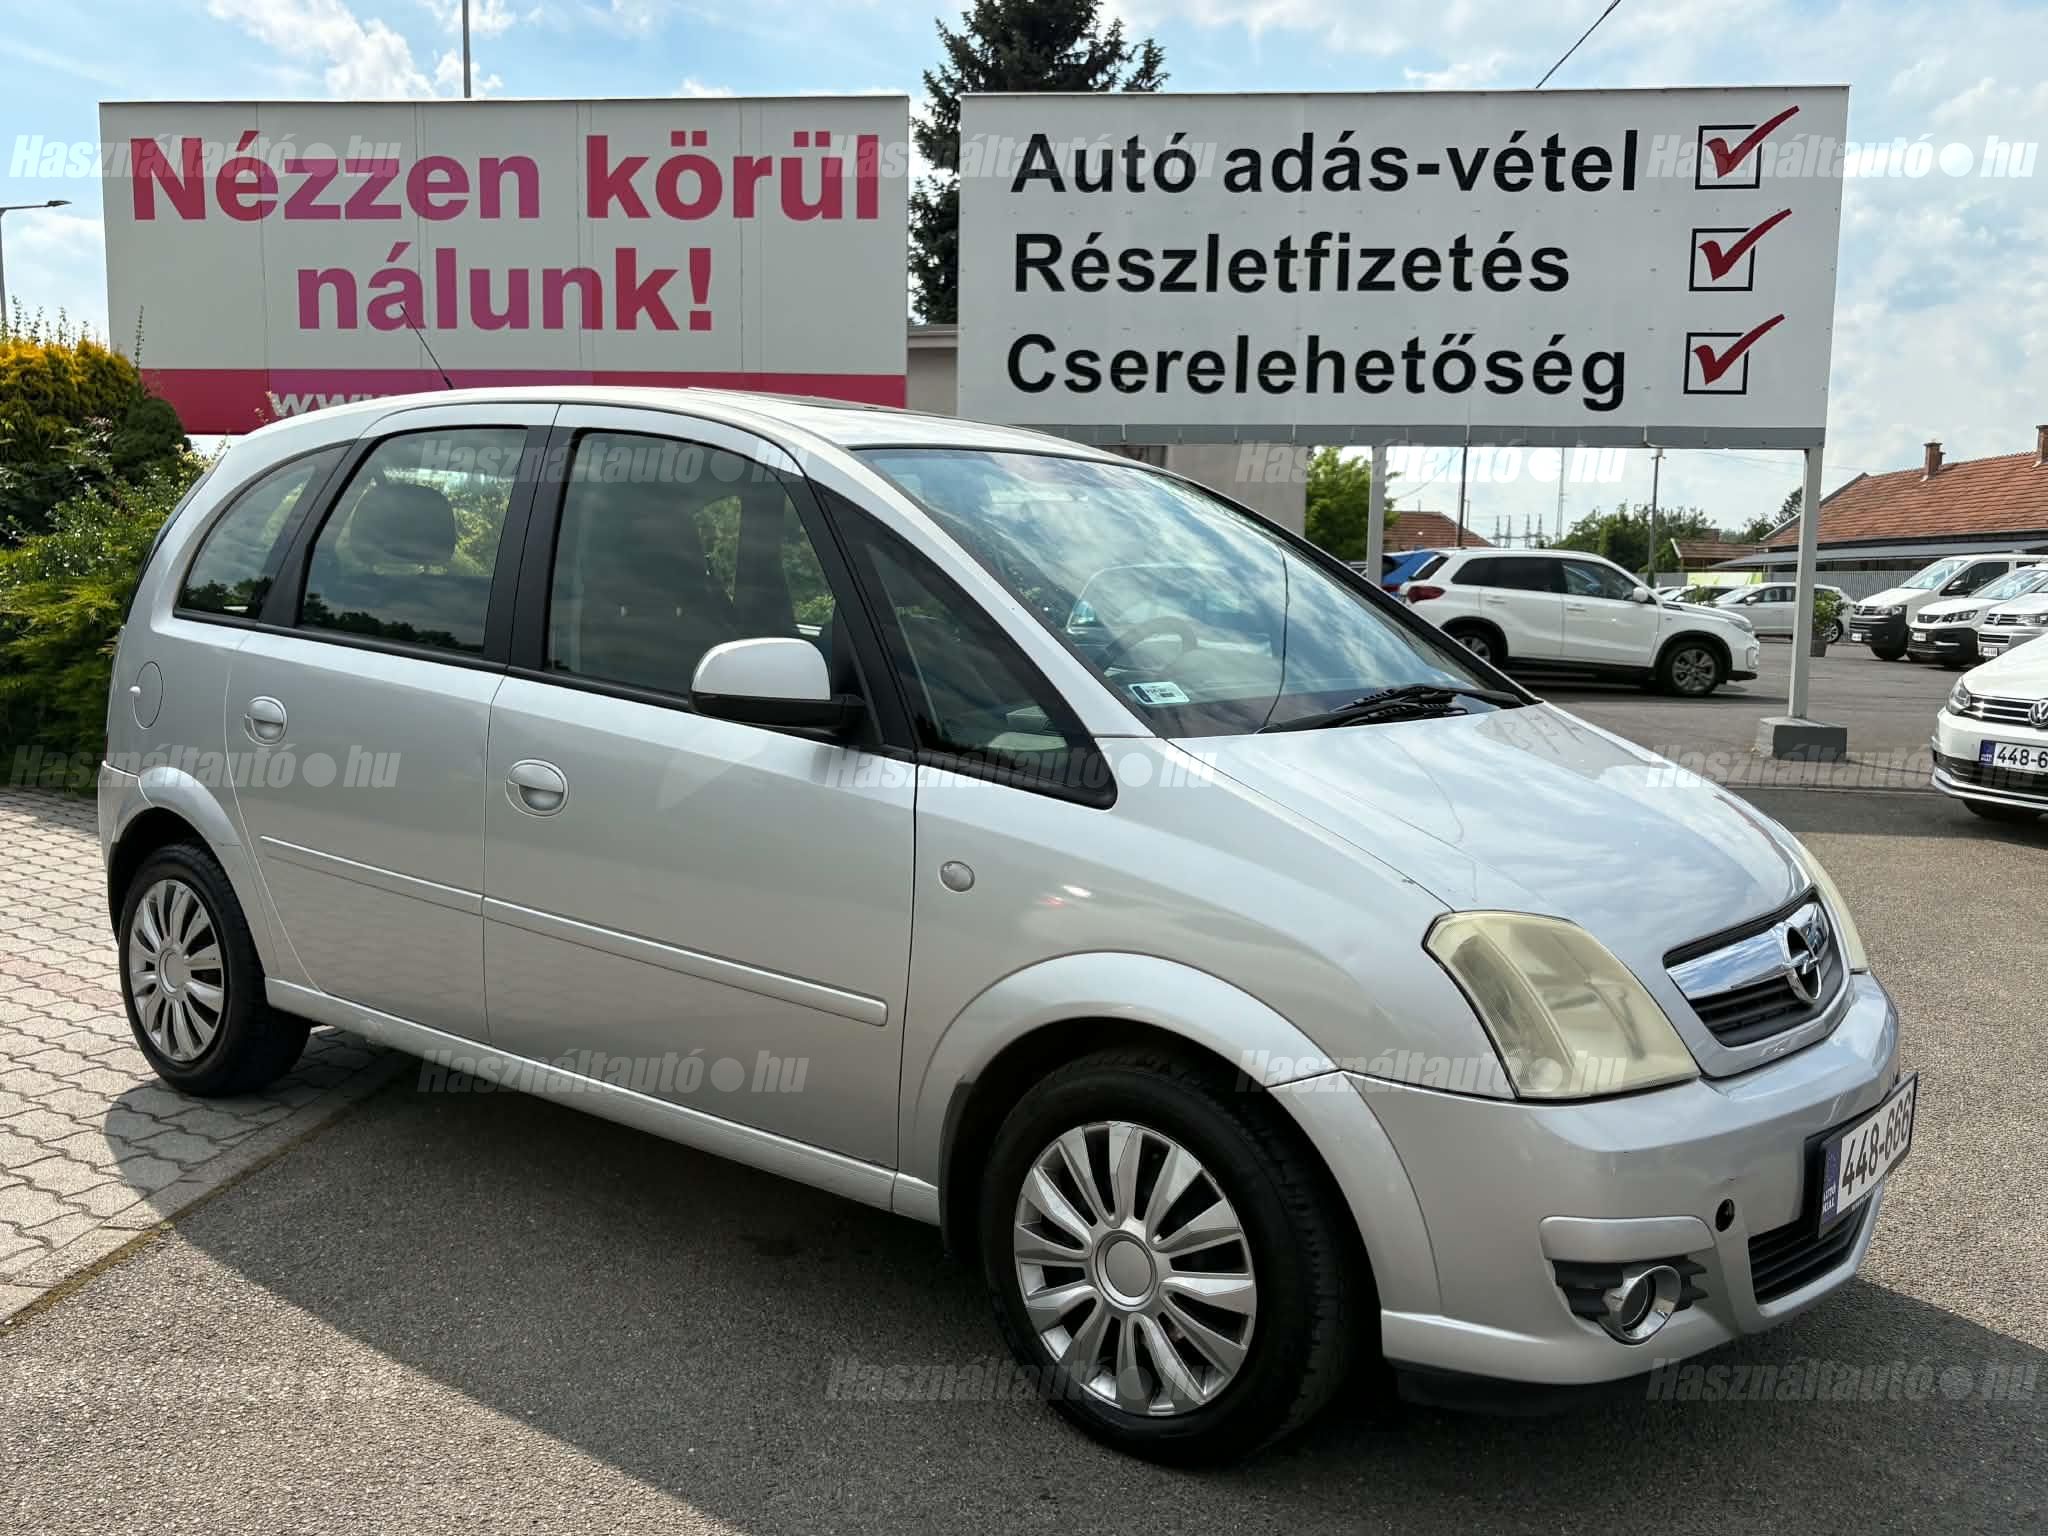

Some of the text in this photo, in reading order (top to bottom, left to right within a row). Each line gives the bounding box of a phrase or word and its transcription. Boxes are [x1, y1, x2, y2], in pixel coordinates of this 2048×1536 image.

[130, 130, 880, 221] Nézzen körül
[1011, 129, 1638, 193] Autó adás-vétel
[297, 241, 713, 331] nálunk!
[1015, 230, 1569, 292] Részletfizetés
[1006, 332, 1626, 412] Cserelehetőség
[1841, 1090, 1912, 1196] 448-666
